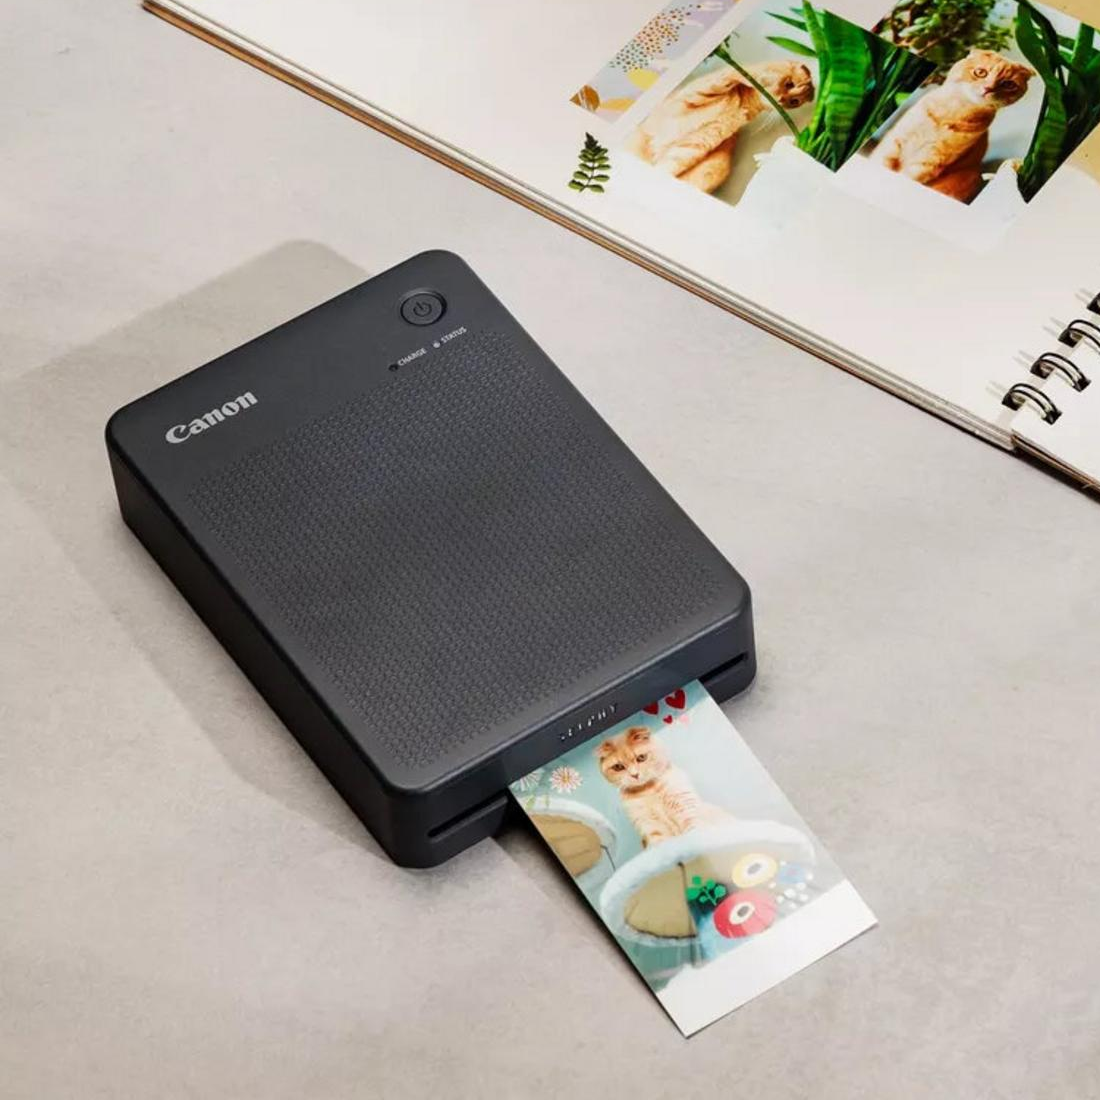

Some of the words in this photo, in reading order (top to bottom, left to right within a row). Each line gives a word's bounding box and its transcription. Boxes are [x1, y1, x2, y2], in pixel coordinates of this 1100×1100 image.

[441, 326, 467, 343] STATUS
[397, 348, 427, 366] CHARGE
[165, 391, 259, 444] Canon
